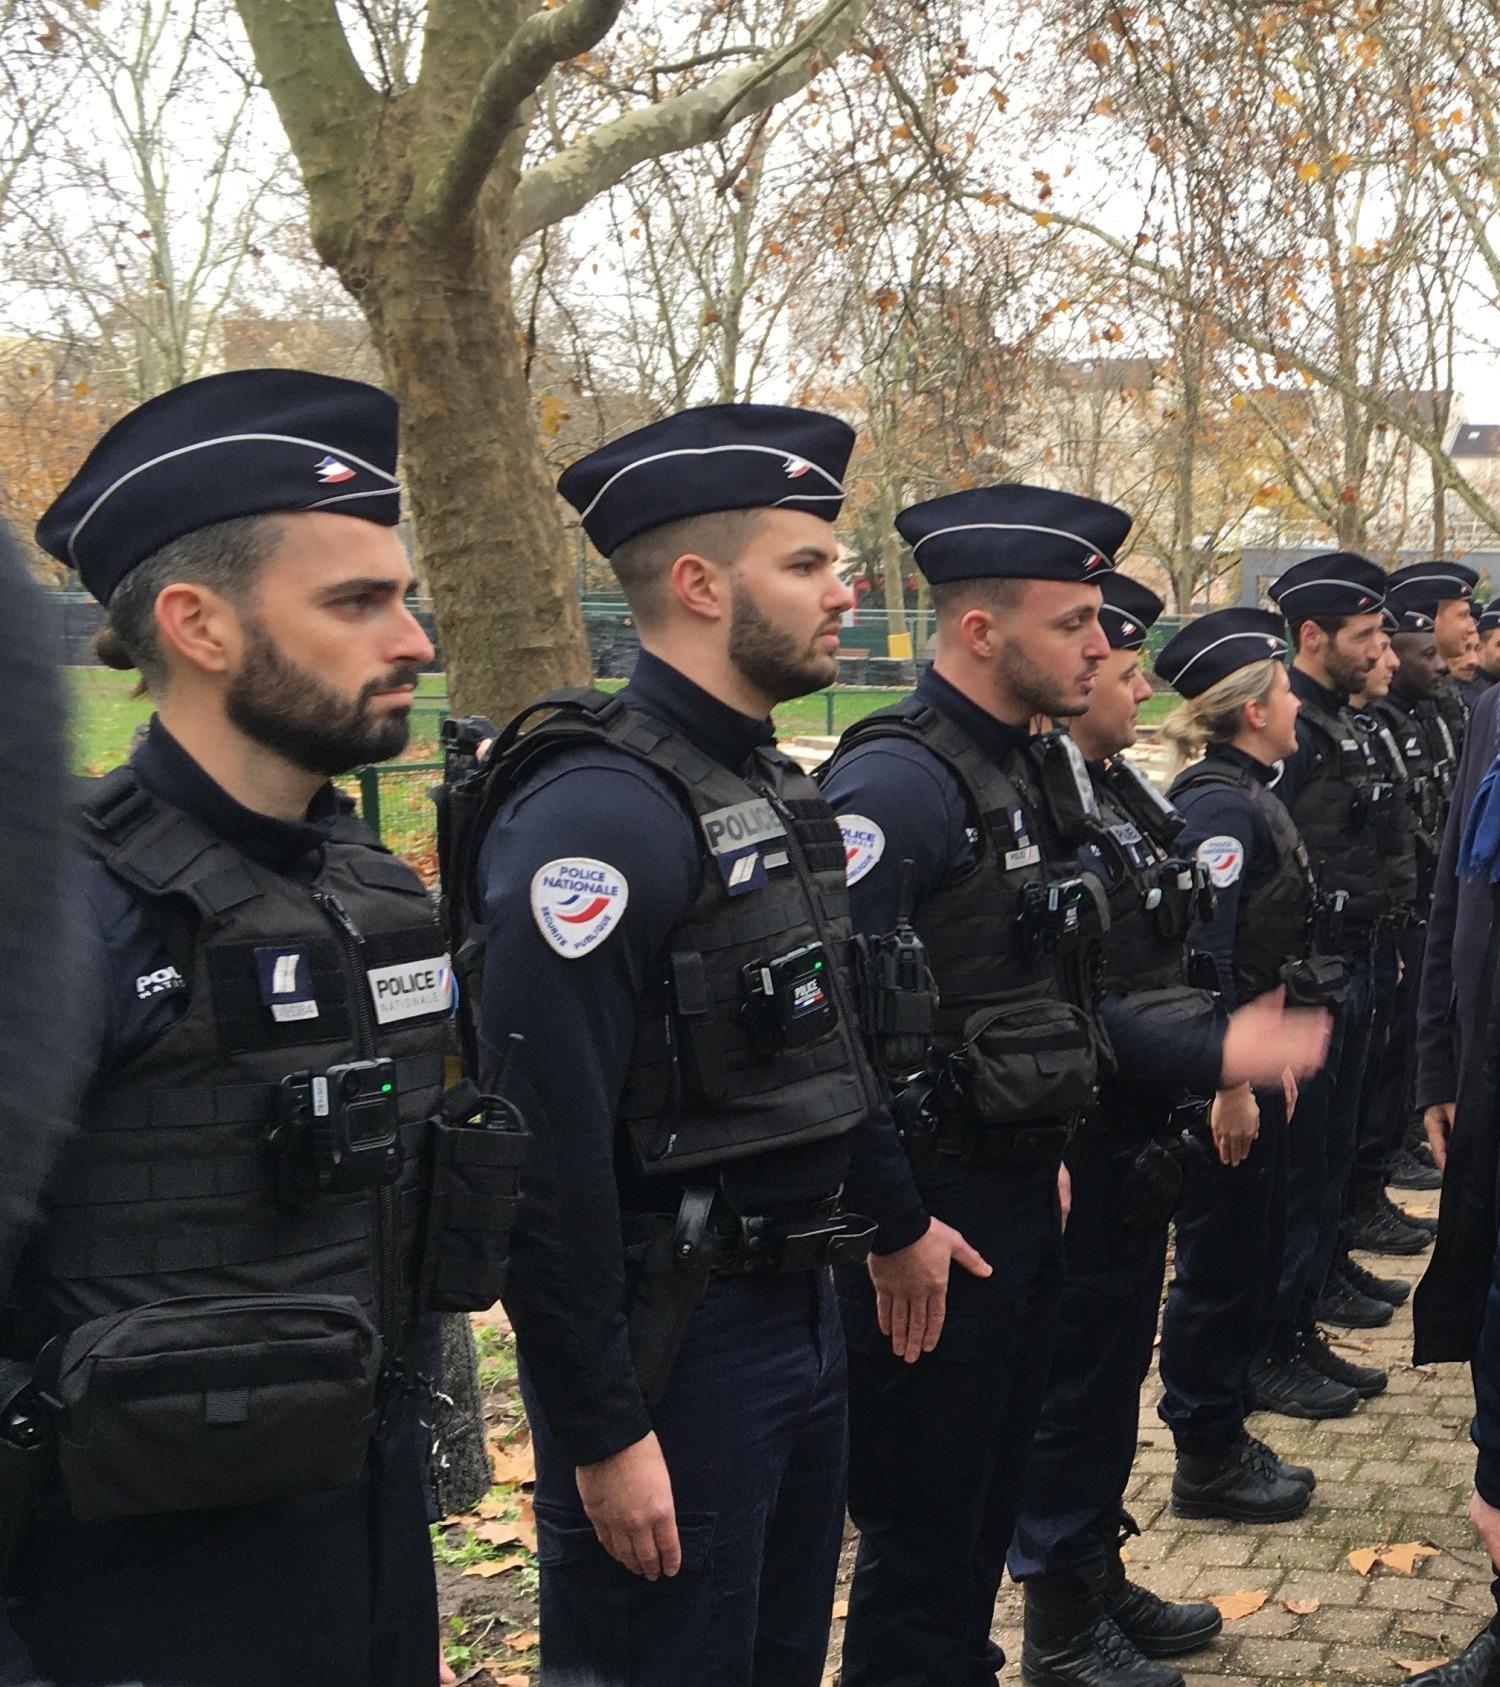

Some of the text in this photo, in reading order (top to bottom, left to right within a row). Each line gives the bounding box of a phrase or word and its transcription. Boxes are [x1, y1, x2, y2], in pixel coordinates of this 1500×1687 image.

[840, 827, 877, 842] OLICE
[560, 866, 606, 882] POLICE
[543, 876, 619, 896] NATIONALE
[136, 966, 182, 992] POL
[376, 970, 436, 999] POLICE
[380, 991, 440, 1012] NATIONALE
